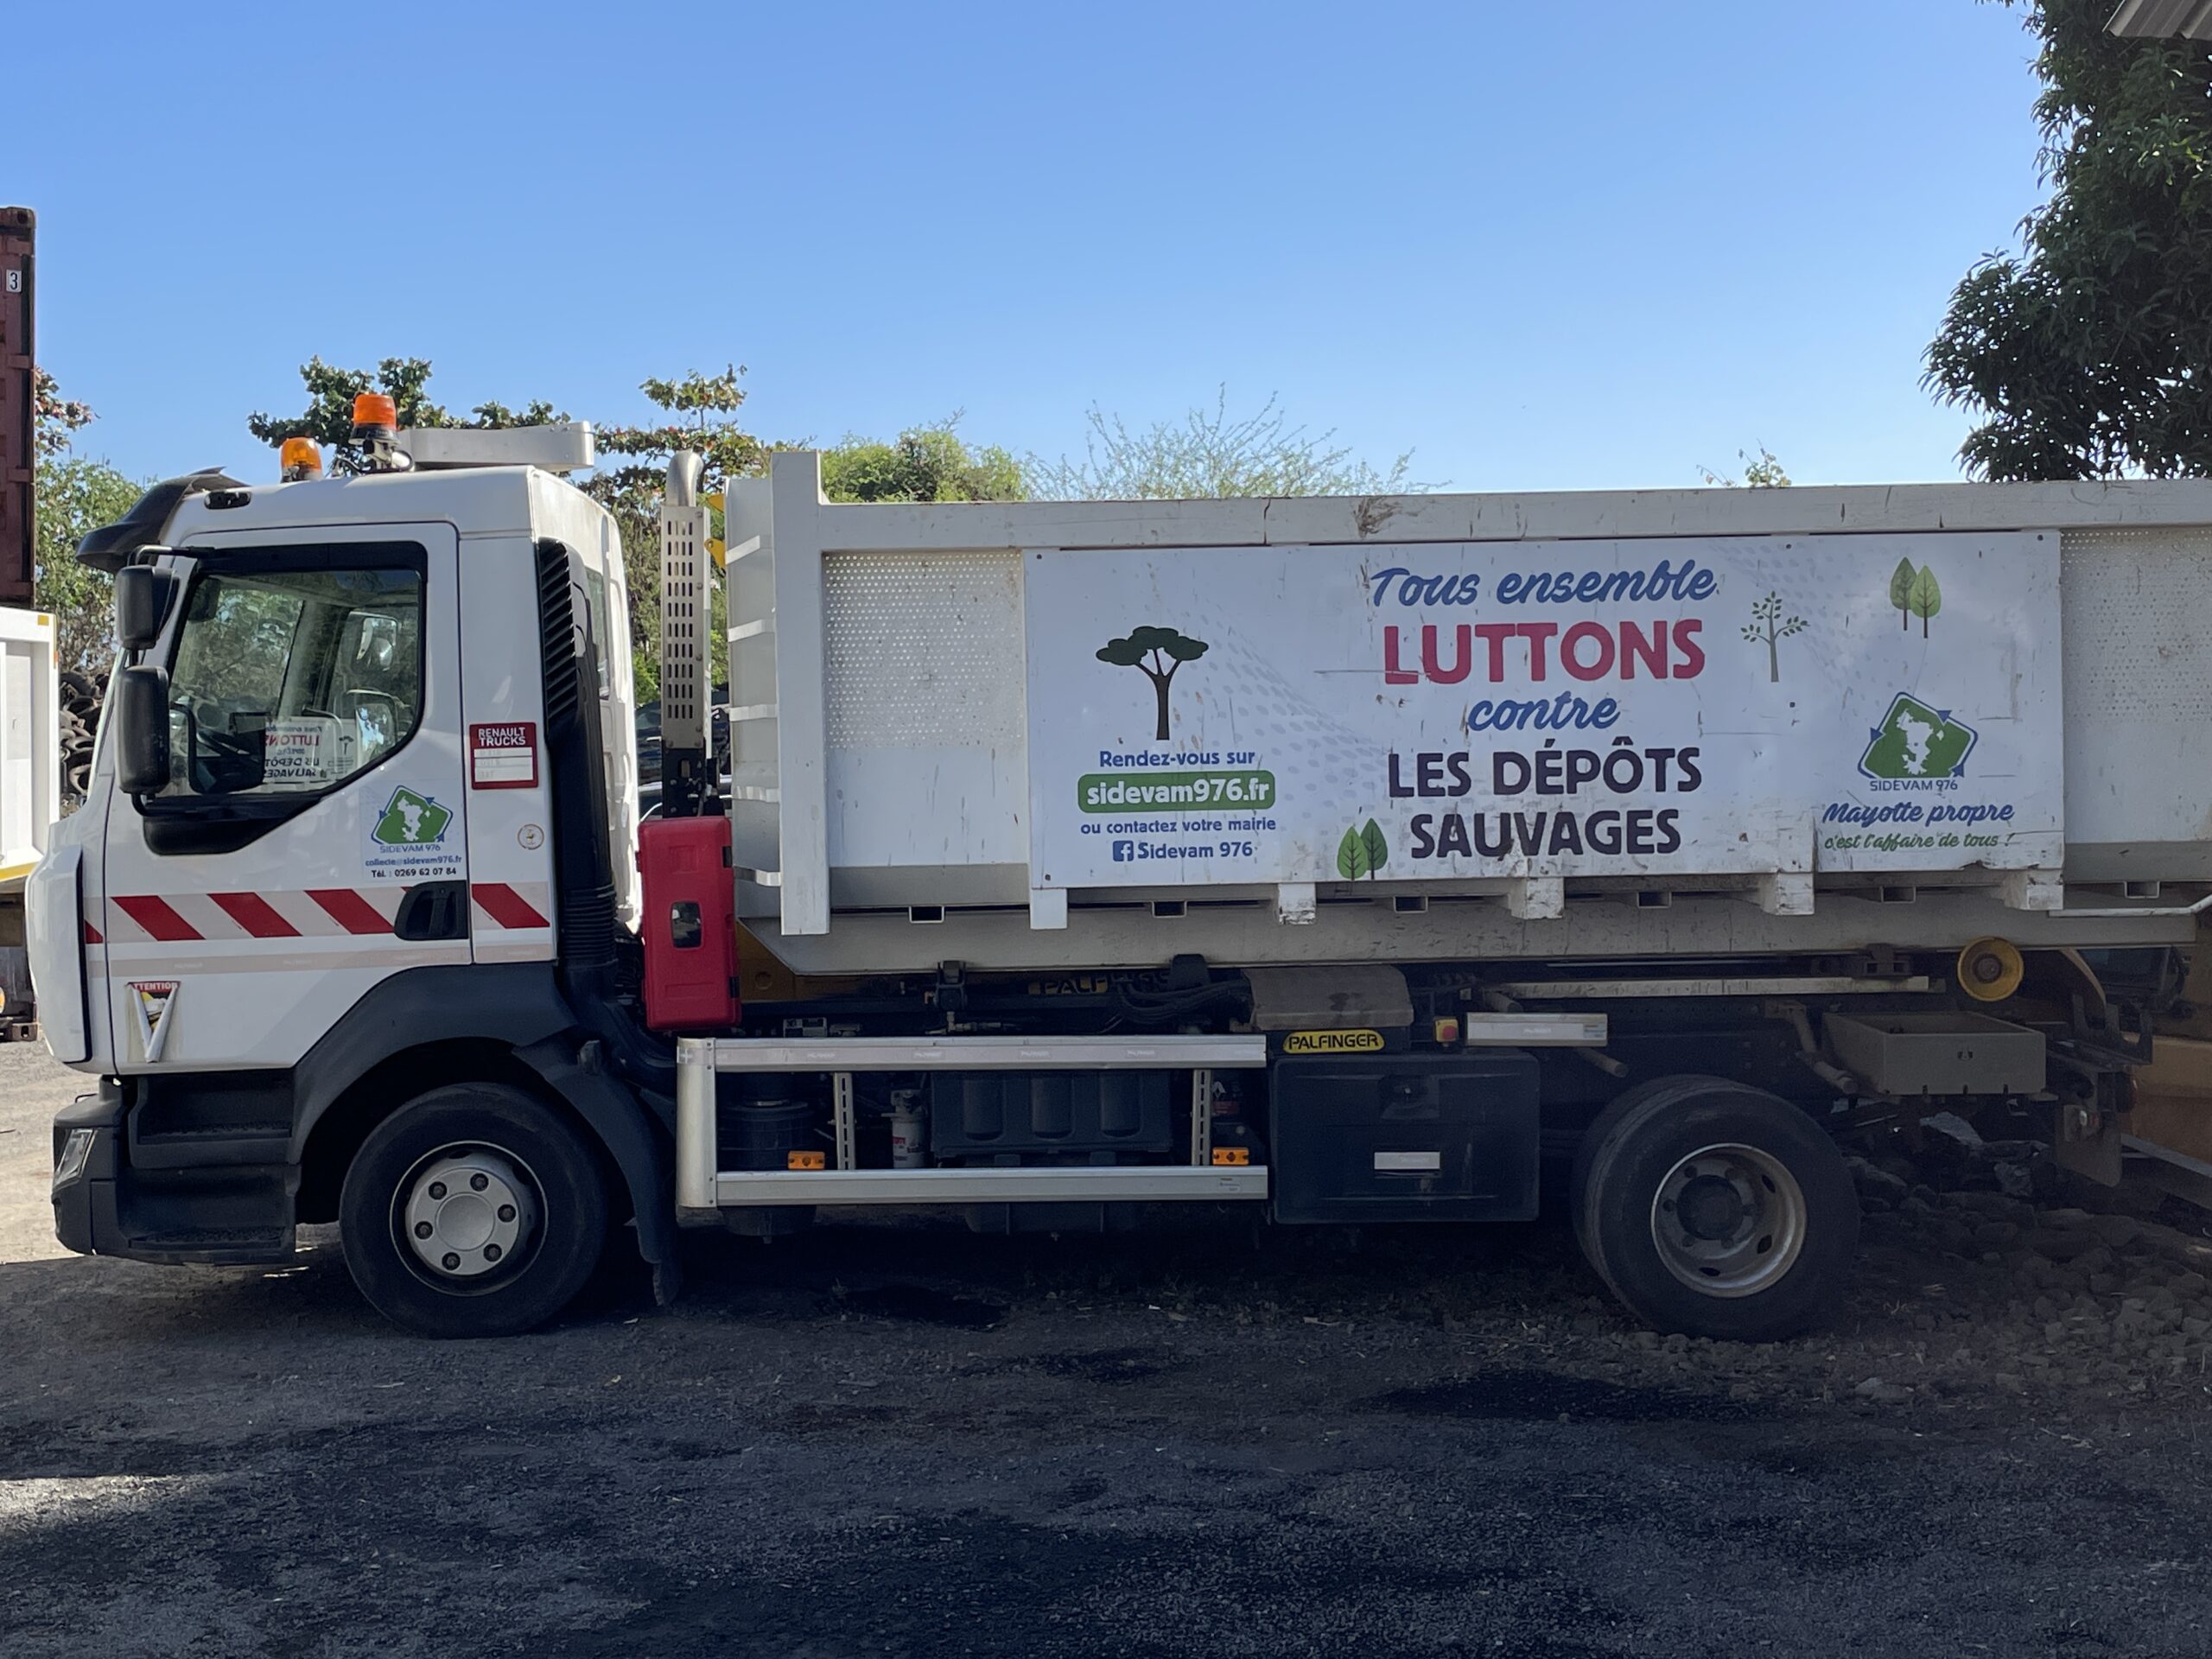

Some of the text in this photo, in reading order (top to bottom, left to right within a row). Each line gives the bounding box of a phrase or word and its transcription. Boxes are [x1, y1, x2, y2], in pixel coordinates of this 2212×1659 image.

[10, 271, 18, 290] 3
[1372, 559, 1717, 606] Tous ensemble
[1384, 620, 1705, 684] LUTTONS
[1468, 691, 1620, 732] contre
[478, 727, 525, 738] RENAULT
[480, 736, 526, 747] TRUCKS
[1099, 750, 1255, 768] Rendez-vous sur
[1389, 735, 1701, 798] LES DÉPÔTS
[1086, 778, 1269, 805] sidevam976.fr
[1869, 779, 1958, 791] SIDEVAM 976
[1821, 802, 2015, 828] Mayotte propre
[1080, 817, 1276, 835] ou contactez votre mairie
[1410, 808, 1681, 861] SAUVAGES
[379, 843, 442, 854] SIDEVAM 976
[1138, 842, 1253, 860] Sidevam 976
[1824, 834, 1861, 850] c'est
[1863, 833, 1935, 851] l'affaire
[1938, 833, 1959, 848] de
[1963, 834, 1999, 847] tous
[365, 855, 462, 867] collecte@sidevam976.fr
[395, 868, 416, 877] 0269
[446, 867, 457, 875] 84
[1287, 1032, 1380, 1051] PALFINGER
